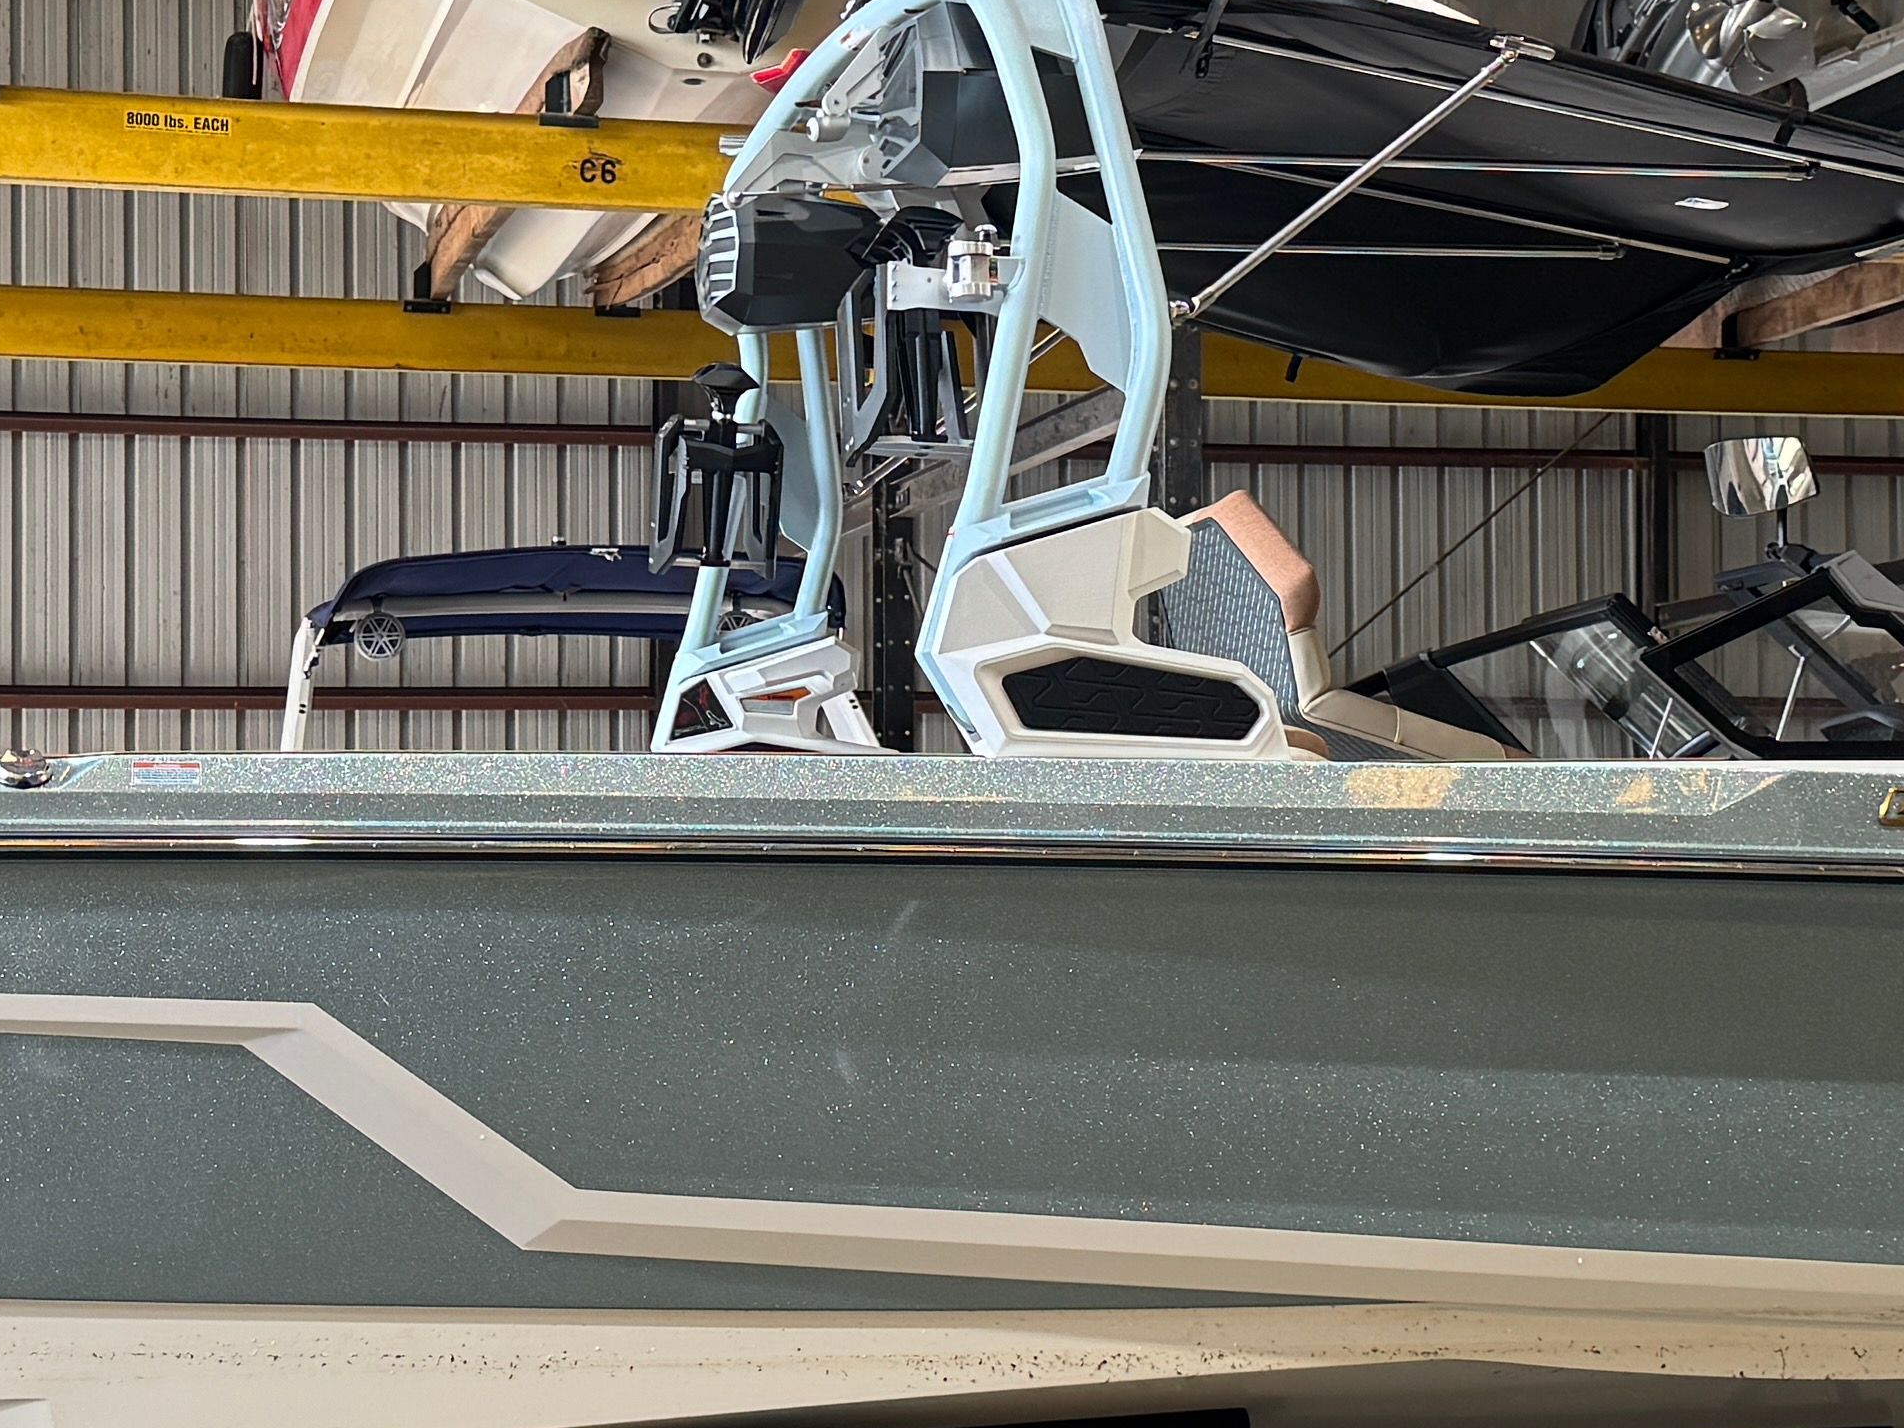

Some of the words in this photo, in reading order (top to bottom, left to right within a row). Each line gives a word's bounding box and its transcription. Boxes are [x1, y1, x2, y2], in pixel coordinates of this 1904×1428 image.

[126, 111, 160, 127] 8000
[163, 115, 189, 129] lbs.
[194, 117, 230, 133] EACH
[580, 158, 617, 185] C6
